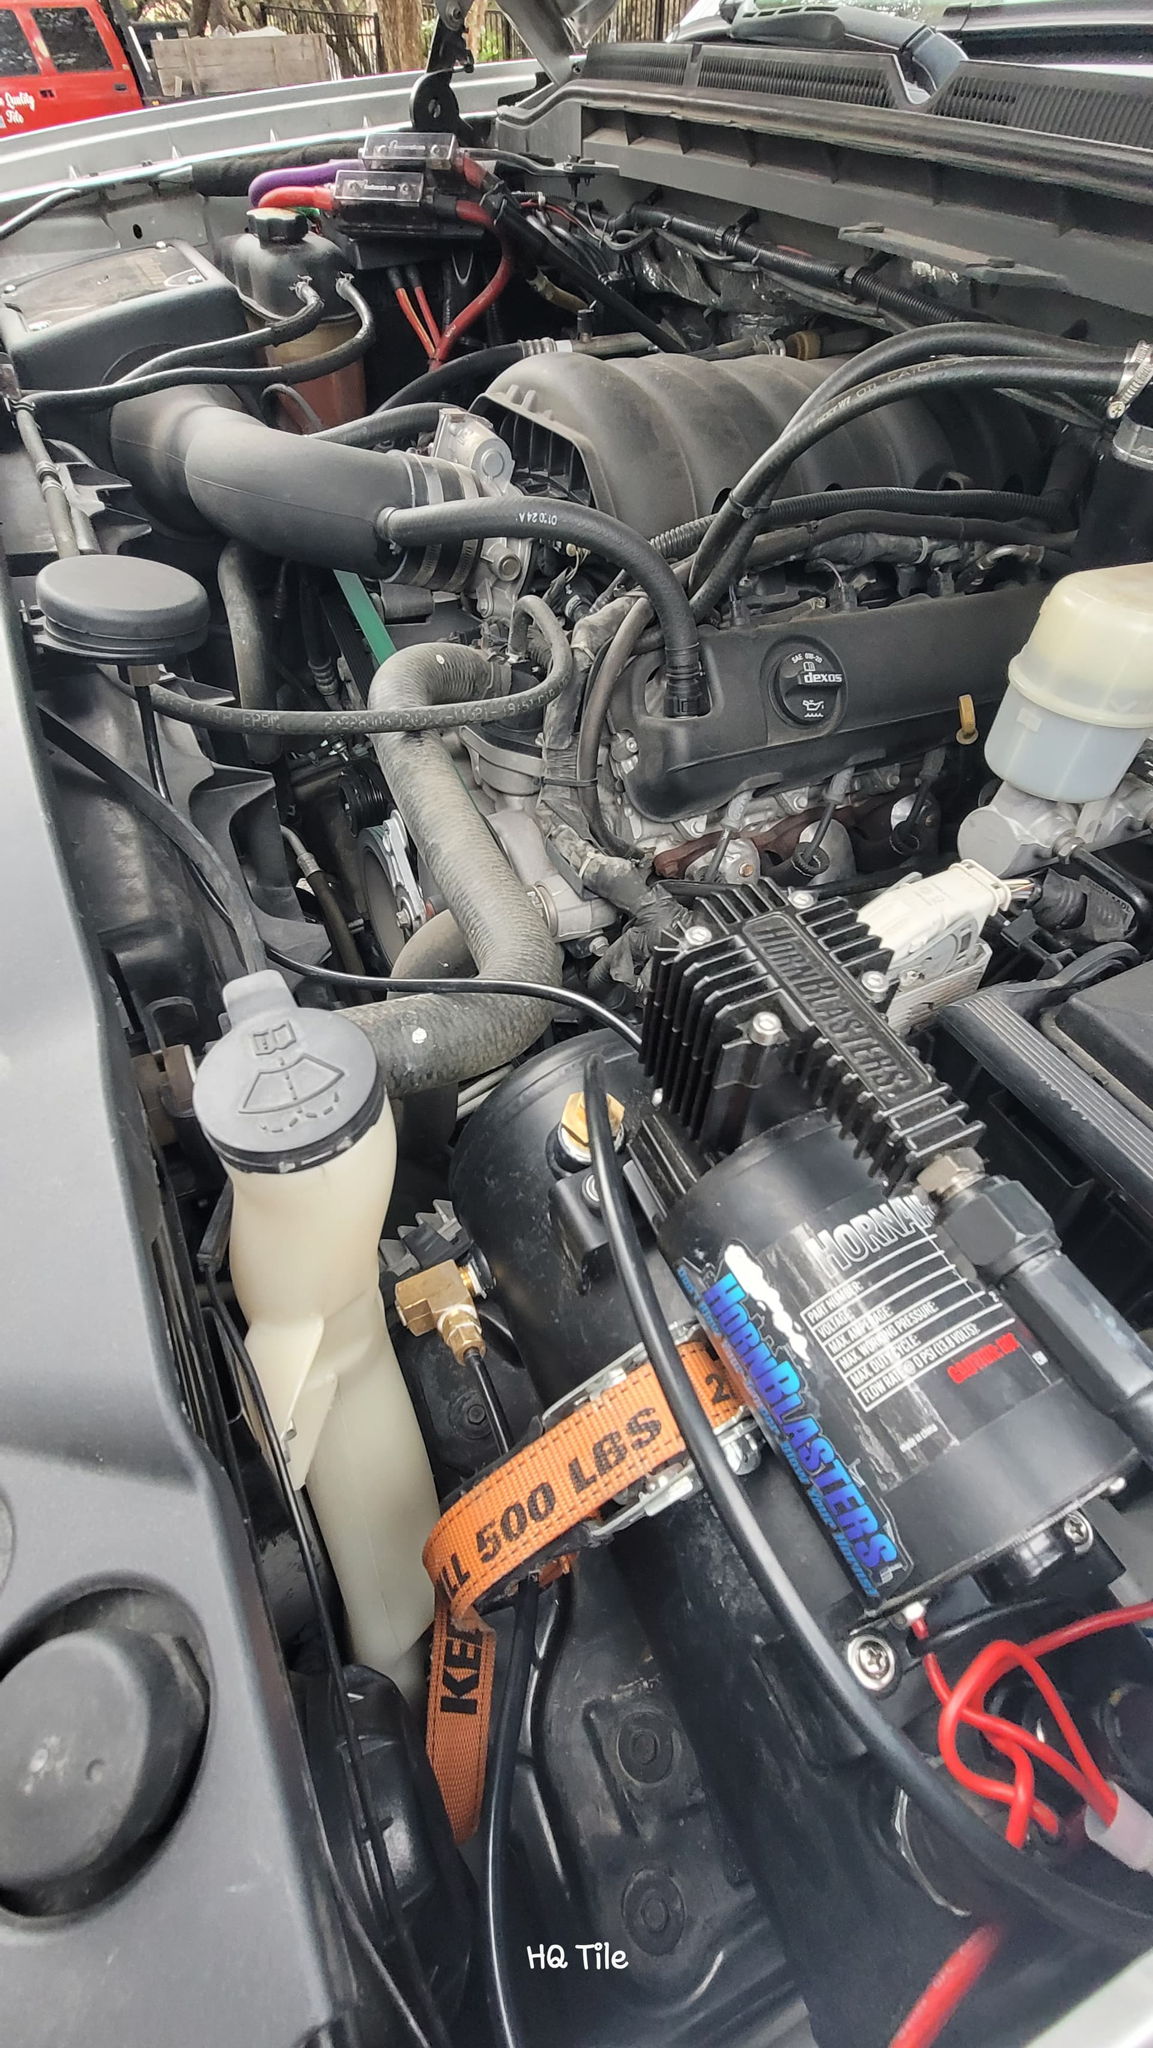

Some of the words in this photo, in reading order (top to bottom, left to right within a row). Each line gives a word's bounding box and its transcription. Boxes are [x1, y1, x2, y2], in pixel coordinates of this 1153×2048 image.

[804, 672, 842, 684] dexos
[806, 1301, 831, 1324] PART
[824, 1279, 864, 1311] NUMBER:
[816, 1308, 855, 1339] VOLTAGE:
[827, 1332, 852, 1355] MAX.
[838, 1347, 862, 1370] MAX.
[894, 1300, 939, 1332] PRESSURE:
[848, 1363, 874, 1386] MAX.
[868, 1349, 893, 1373] DUTY
[859, 1378, 888, 1404] FLOW
[918, 1344, 939, 1365] PSI
[700, 1271, 900, 1572] HORNBLASTERS
[475, 1481, 556, 1563] 500
[567, 1407, 662, 1495] LBS
[779, 1440, 810, 1486] Blow
[805, 1484, 838, 1531] Your
